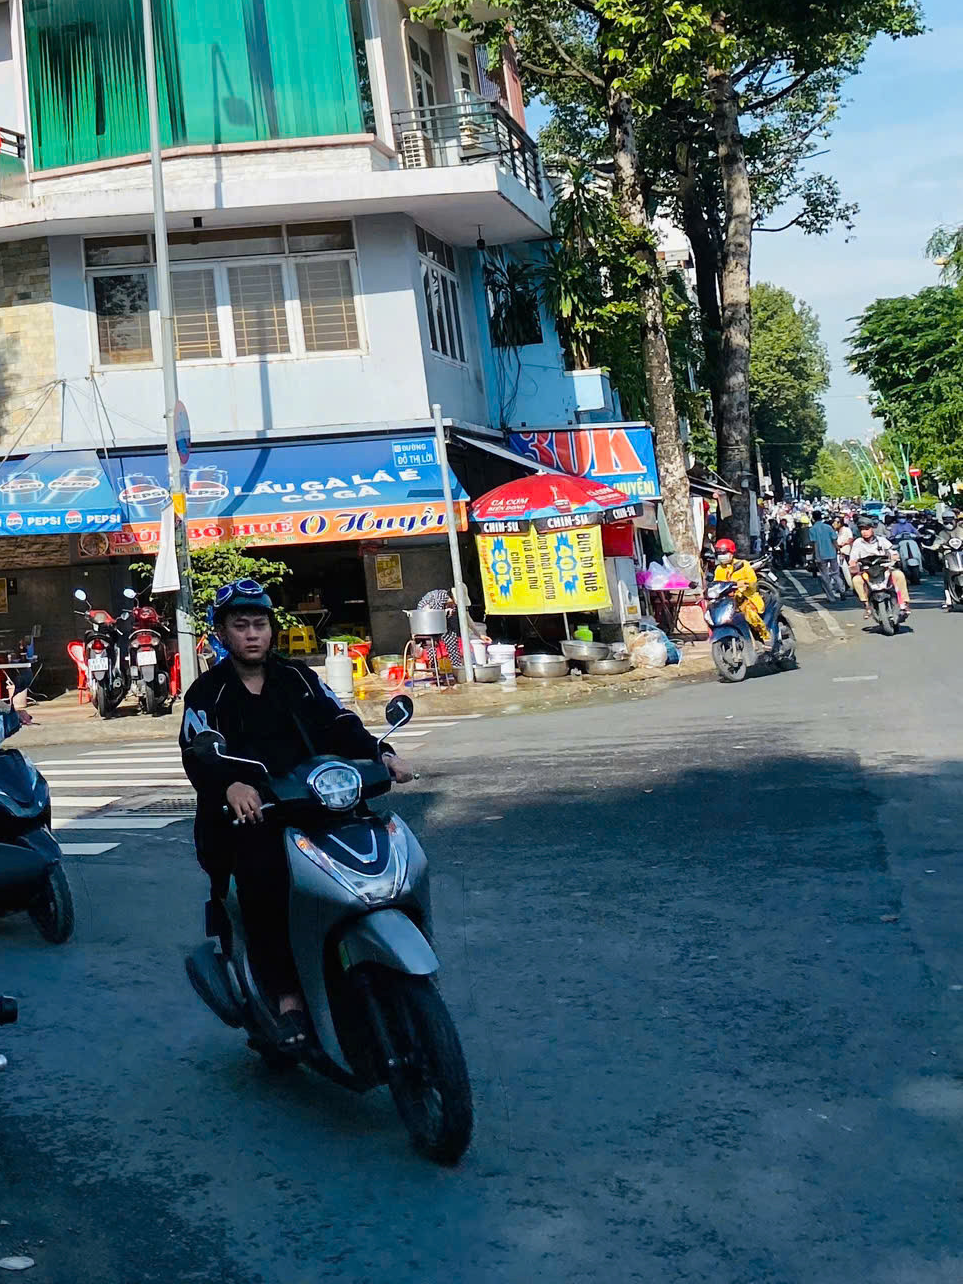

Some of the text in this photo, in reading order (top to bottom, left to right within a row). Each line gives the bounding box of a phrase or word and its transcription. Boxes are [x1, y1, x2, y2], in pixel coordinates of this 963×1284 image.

[398, 468, 422, 482] É
[27, 515, 61, 527] PEPSI
[86, 514, 121, 525] PEPSI
[188, 523, 224, 539] BÒ
[232, 517, 294, 536] HUẾ
[299, 515, 329, 536] O
[483, 522, 520, 533] CHIN-SU
[547, 514, 588, 528] CHIN-SU
